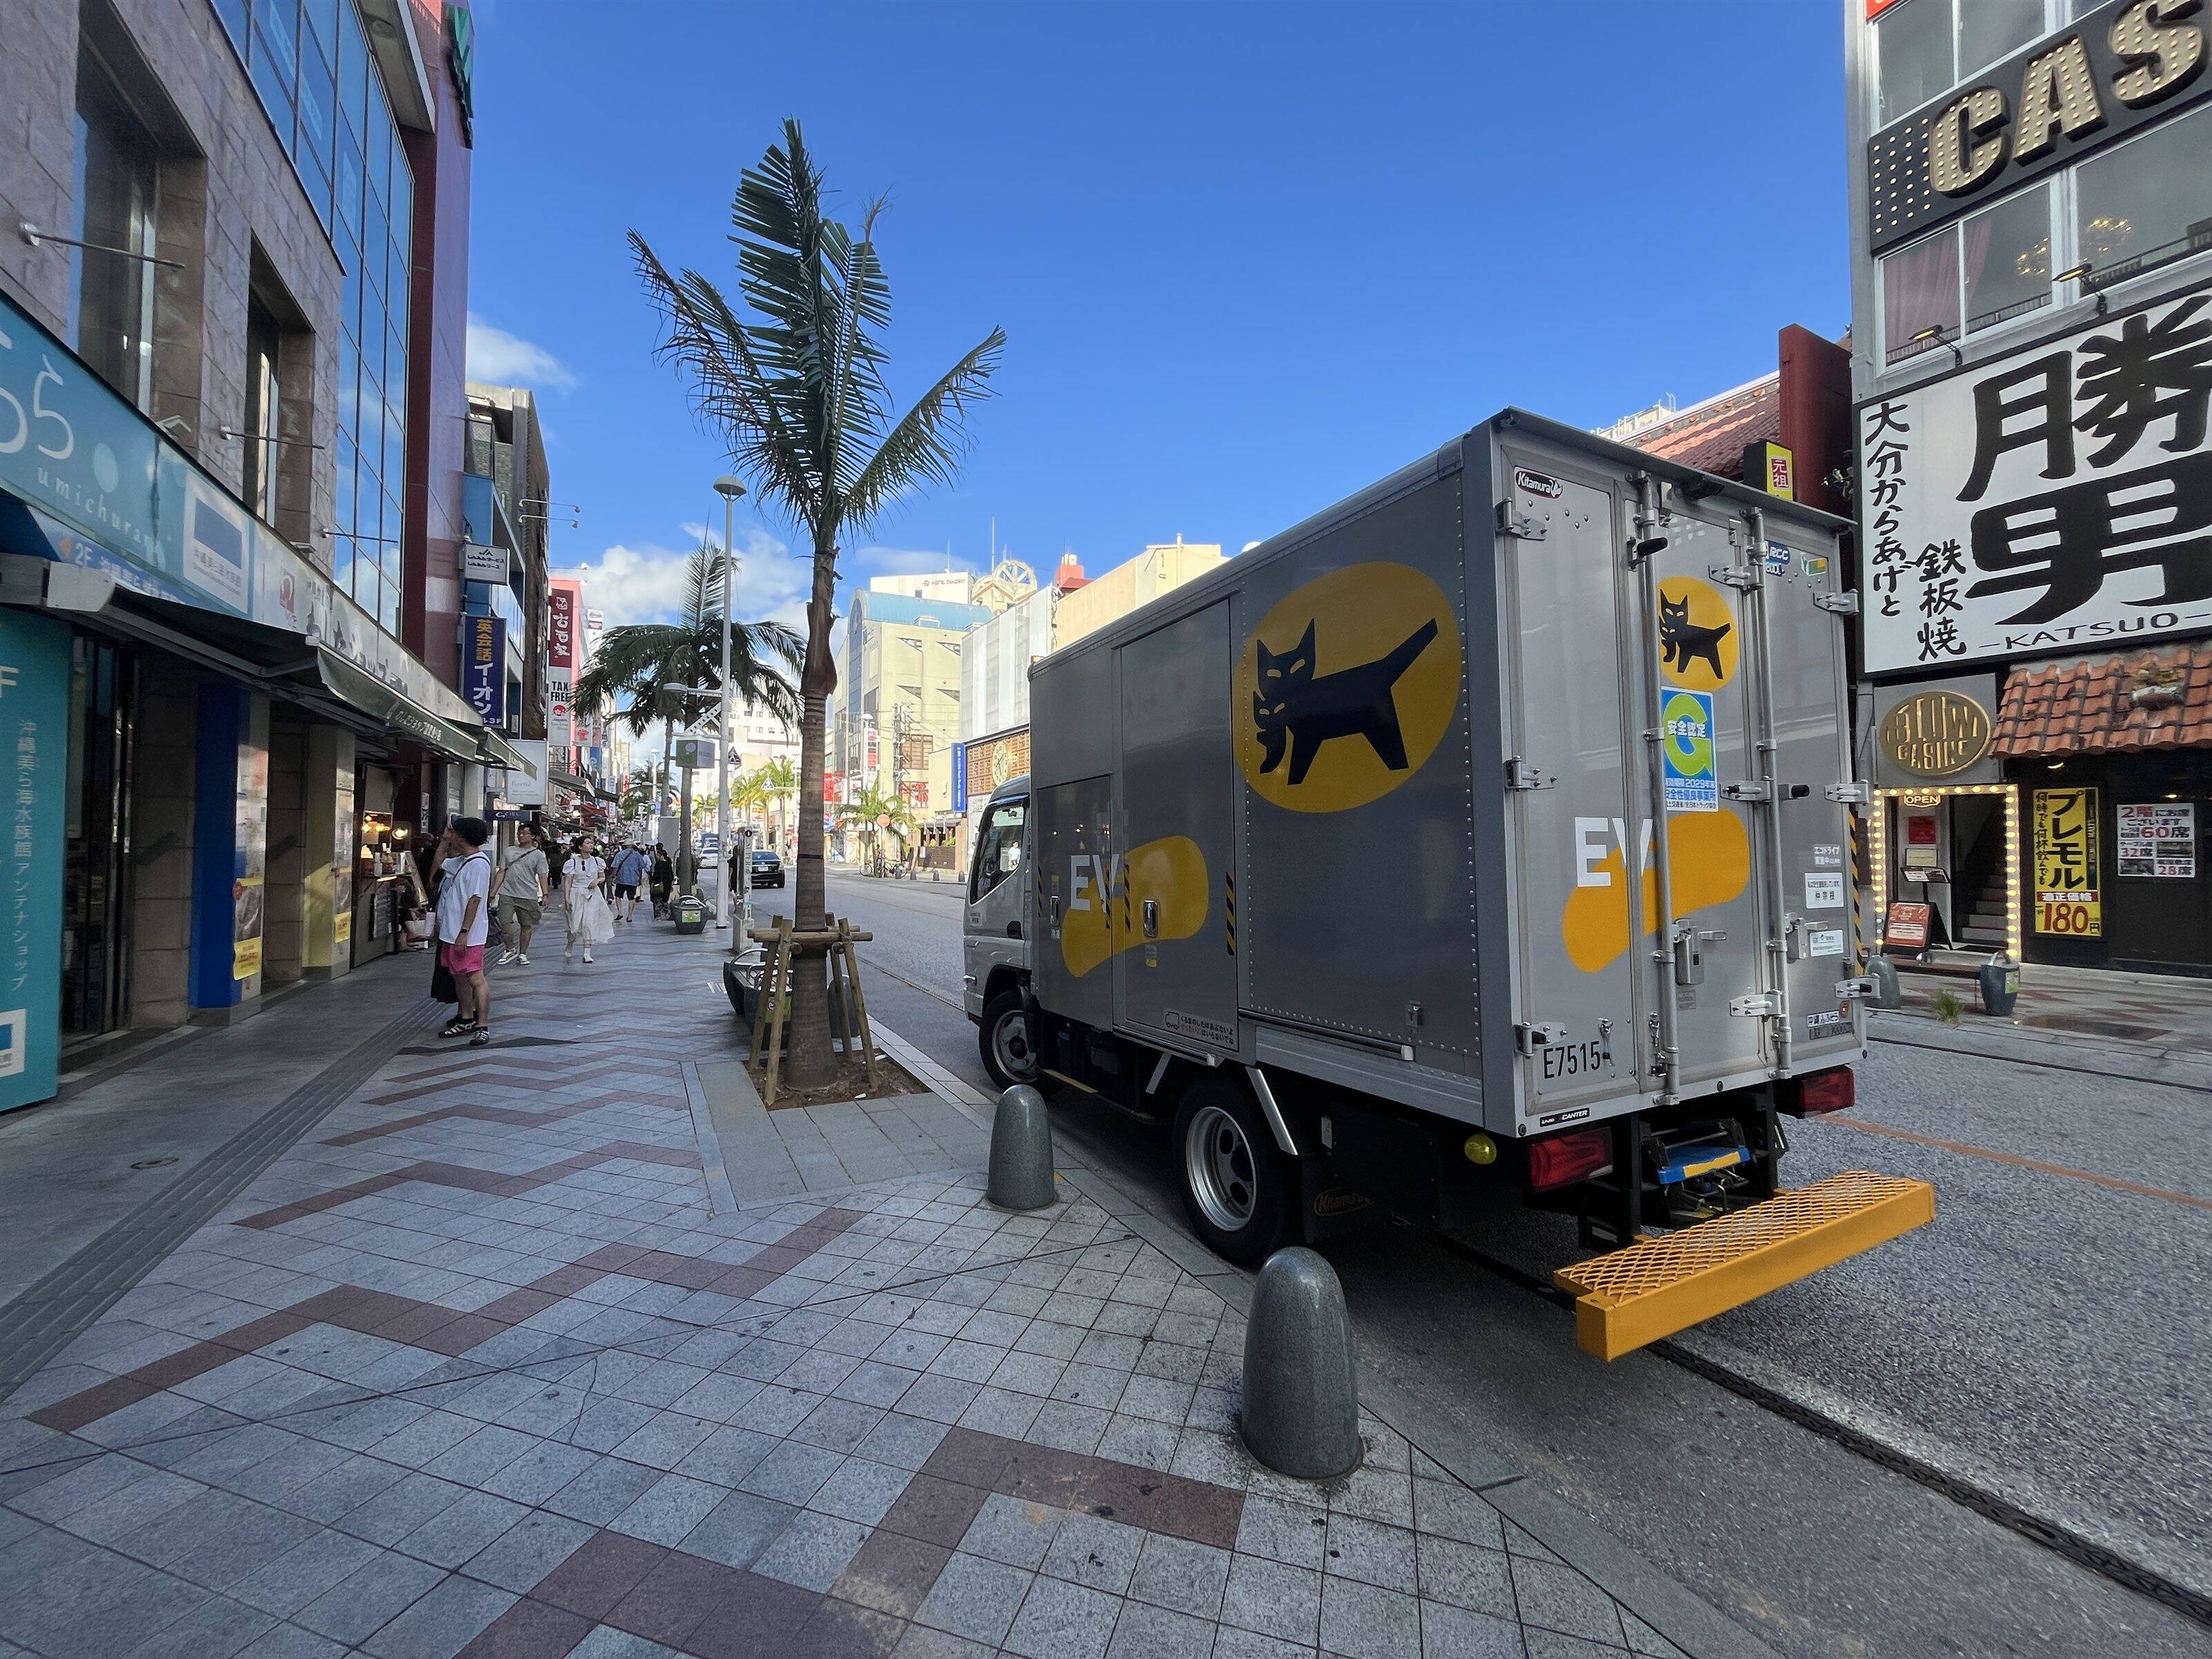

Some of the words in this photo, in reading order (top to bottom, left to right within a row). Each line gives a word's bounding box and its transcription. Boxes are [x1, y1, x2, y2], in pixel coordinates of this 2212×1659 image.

[1517, 471, 1551, 494] Kitamura
[1772, 459, 1789, 488] 元祖
[1864, 401, 1911, 618] 大分からあげと
[1916, 536, 1968, 662] 鉄板焼
[2005, 610, 2180, 651] KATSUO
[550, 691, 570, 702] FREE
[552, 681, 569, 691] TAX
[1667, 720, 1706, 738] 安全認定
[1906, 795, 1938, 804] OPEN
[2048, 789, 2085, 890] プレモル
[2140, 826, 2190, 838] 60席
[1575, 816, 1654, 888] EV
[1071, 854, 1120, 913] EV
[1543, 1040, 1601, 1080] E7515
[1562, 1109, 1588, 1121] CANTER
